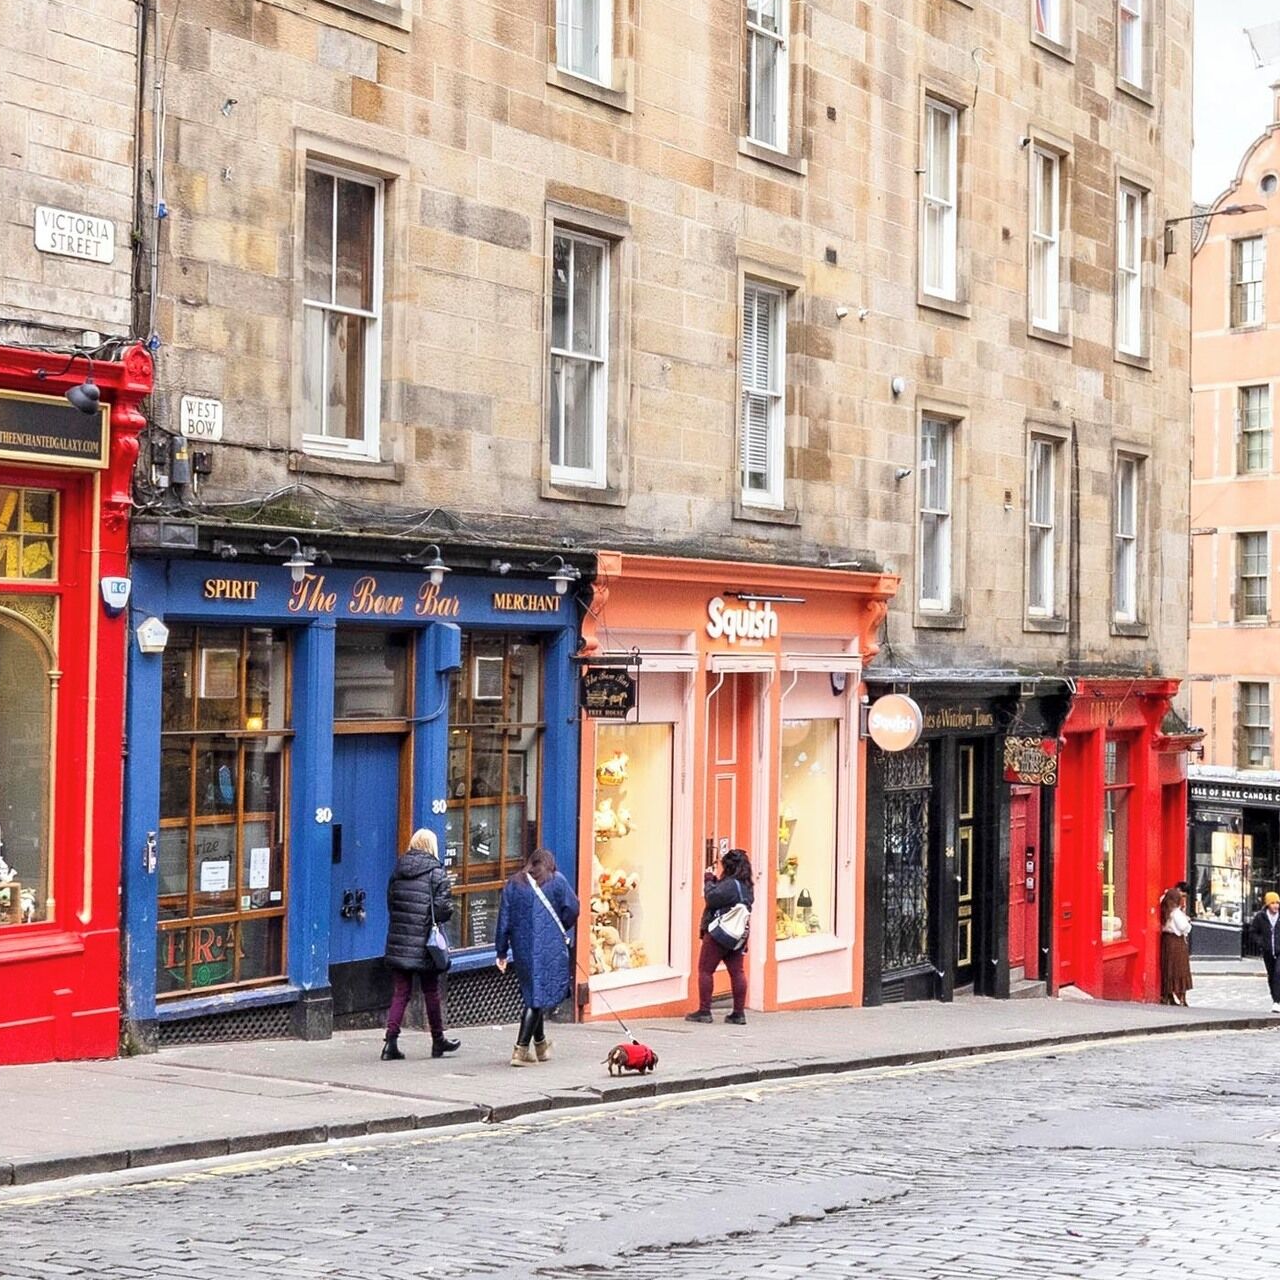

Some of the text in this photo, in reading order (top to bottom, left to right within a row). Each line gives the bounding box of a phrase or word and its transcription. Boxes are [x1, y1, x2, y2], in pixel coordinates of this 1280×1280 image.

[41, 210, 109, 240] VICTORIA
[51, 232, 101, 257] STREET
[186, 400, 219, 419] WEST
[188, 418, 216, 436] BOW
[204, 573, 562, 617] SPIRIT The Bow Bar MERCHANT
[706, 596, 778, 643] Squish
[1191, 786, 1206, 796] ISLE
[1209, 788, 1219, 797] OF
[1221, 789, 1240, 798] SKYE
[1243, 791, 1272, 801] CANDLE
